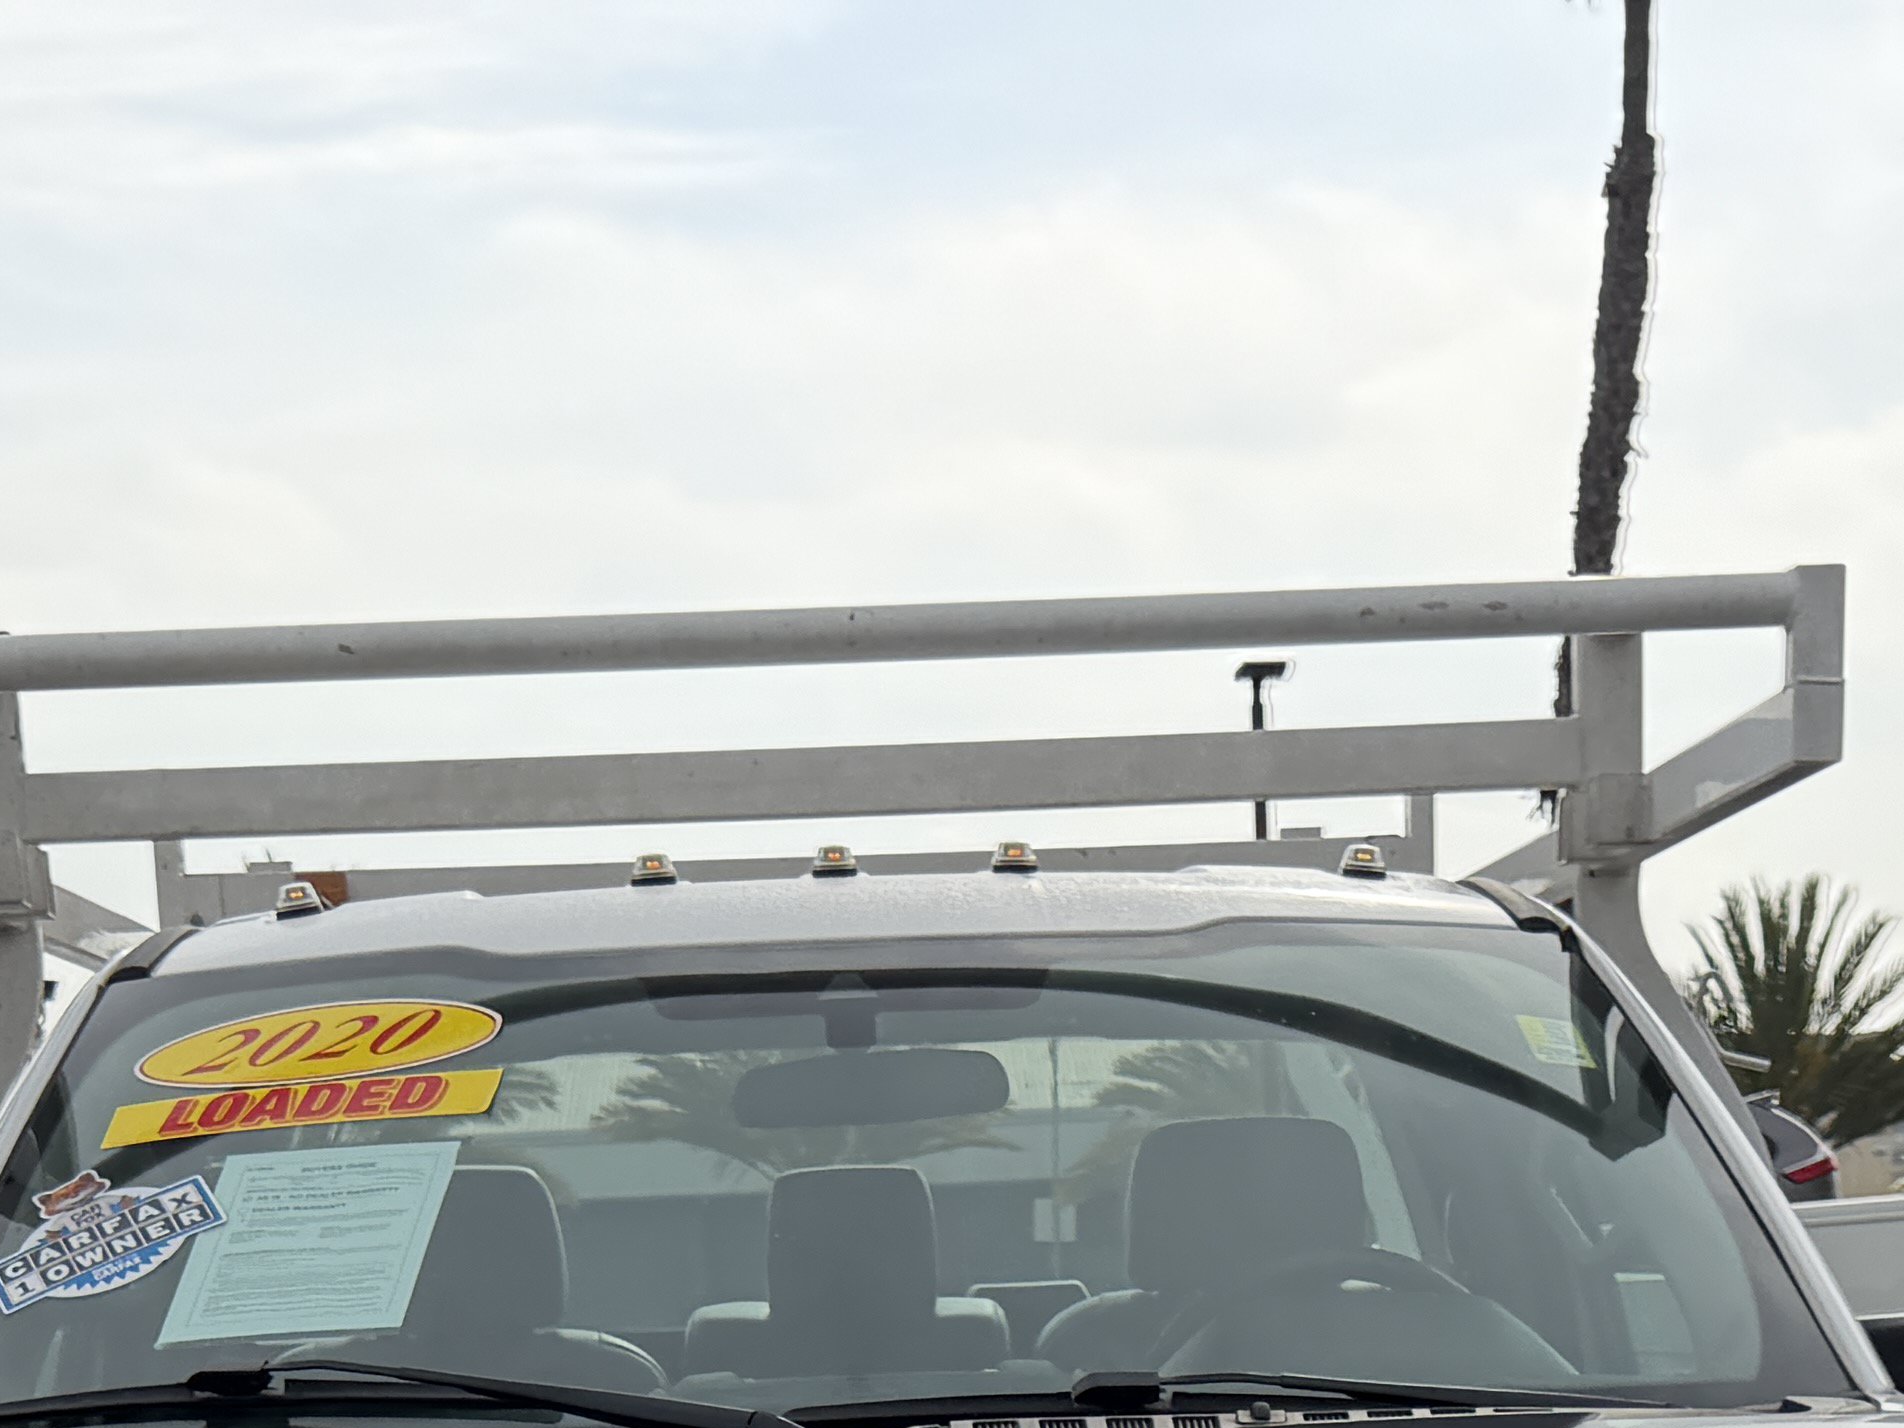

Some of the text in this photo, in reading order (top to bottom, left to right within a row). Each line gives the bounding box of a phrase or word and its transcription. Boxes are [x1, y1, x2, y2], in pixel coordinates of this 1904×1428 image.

[180, 1008, 443, 1077] 2020
[158, 1074, 451, 1137] LOADED
[3, 1190, 195, 1280] CARFAX
[46, 1208, 205, 1282] OWNER
